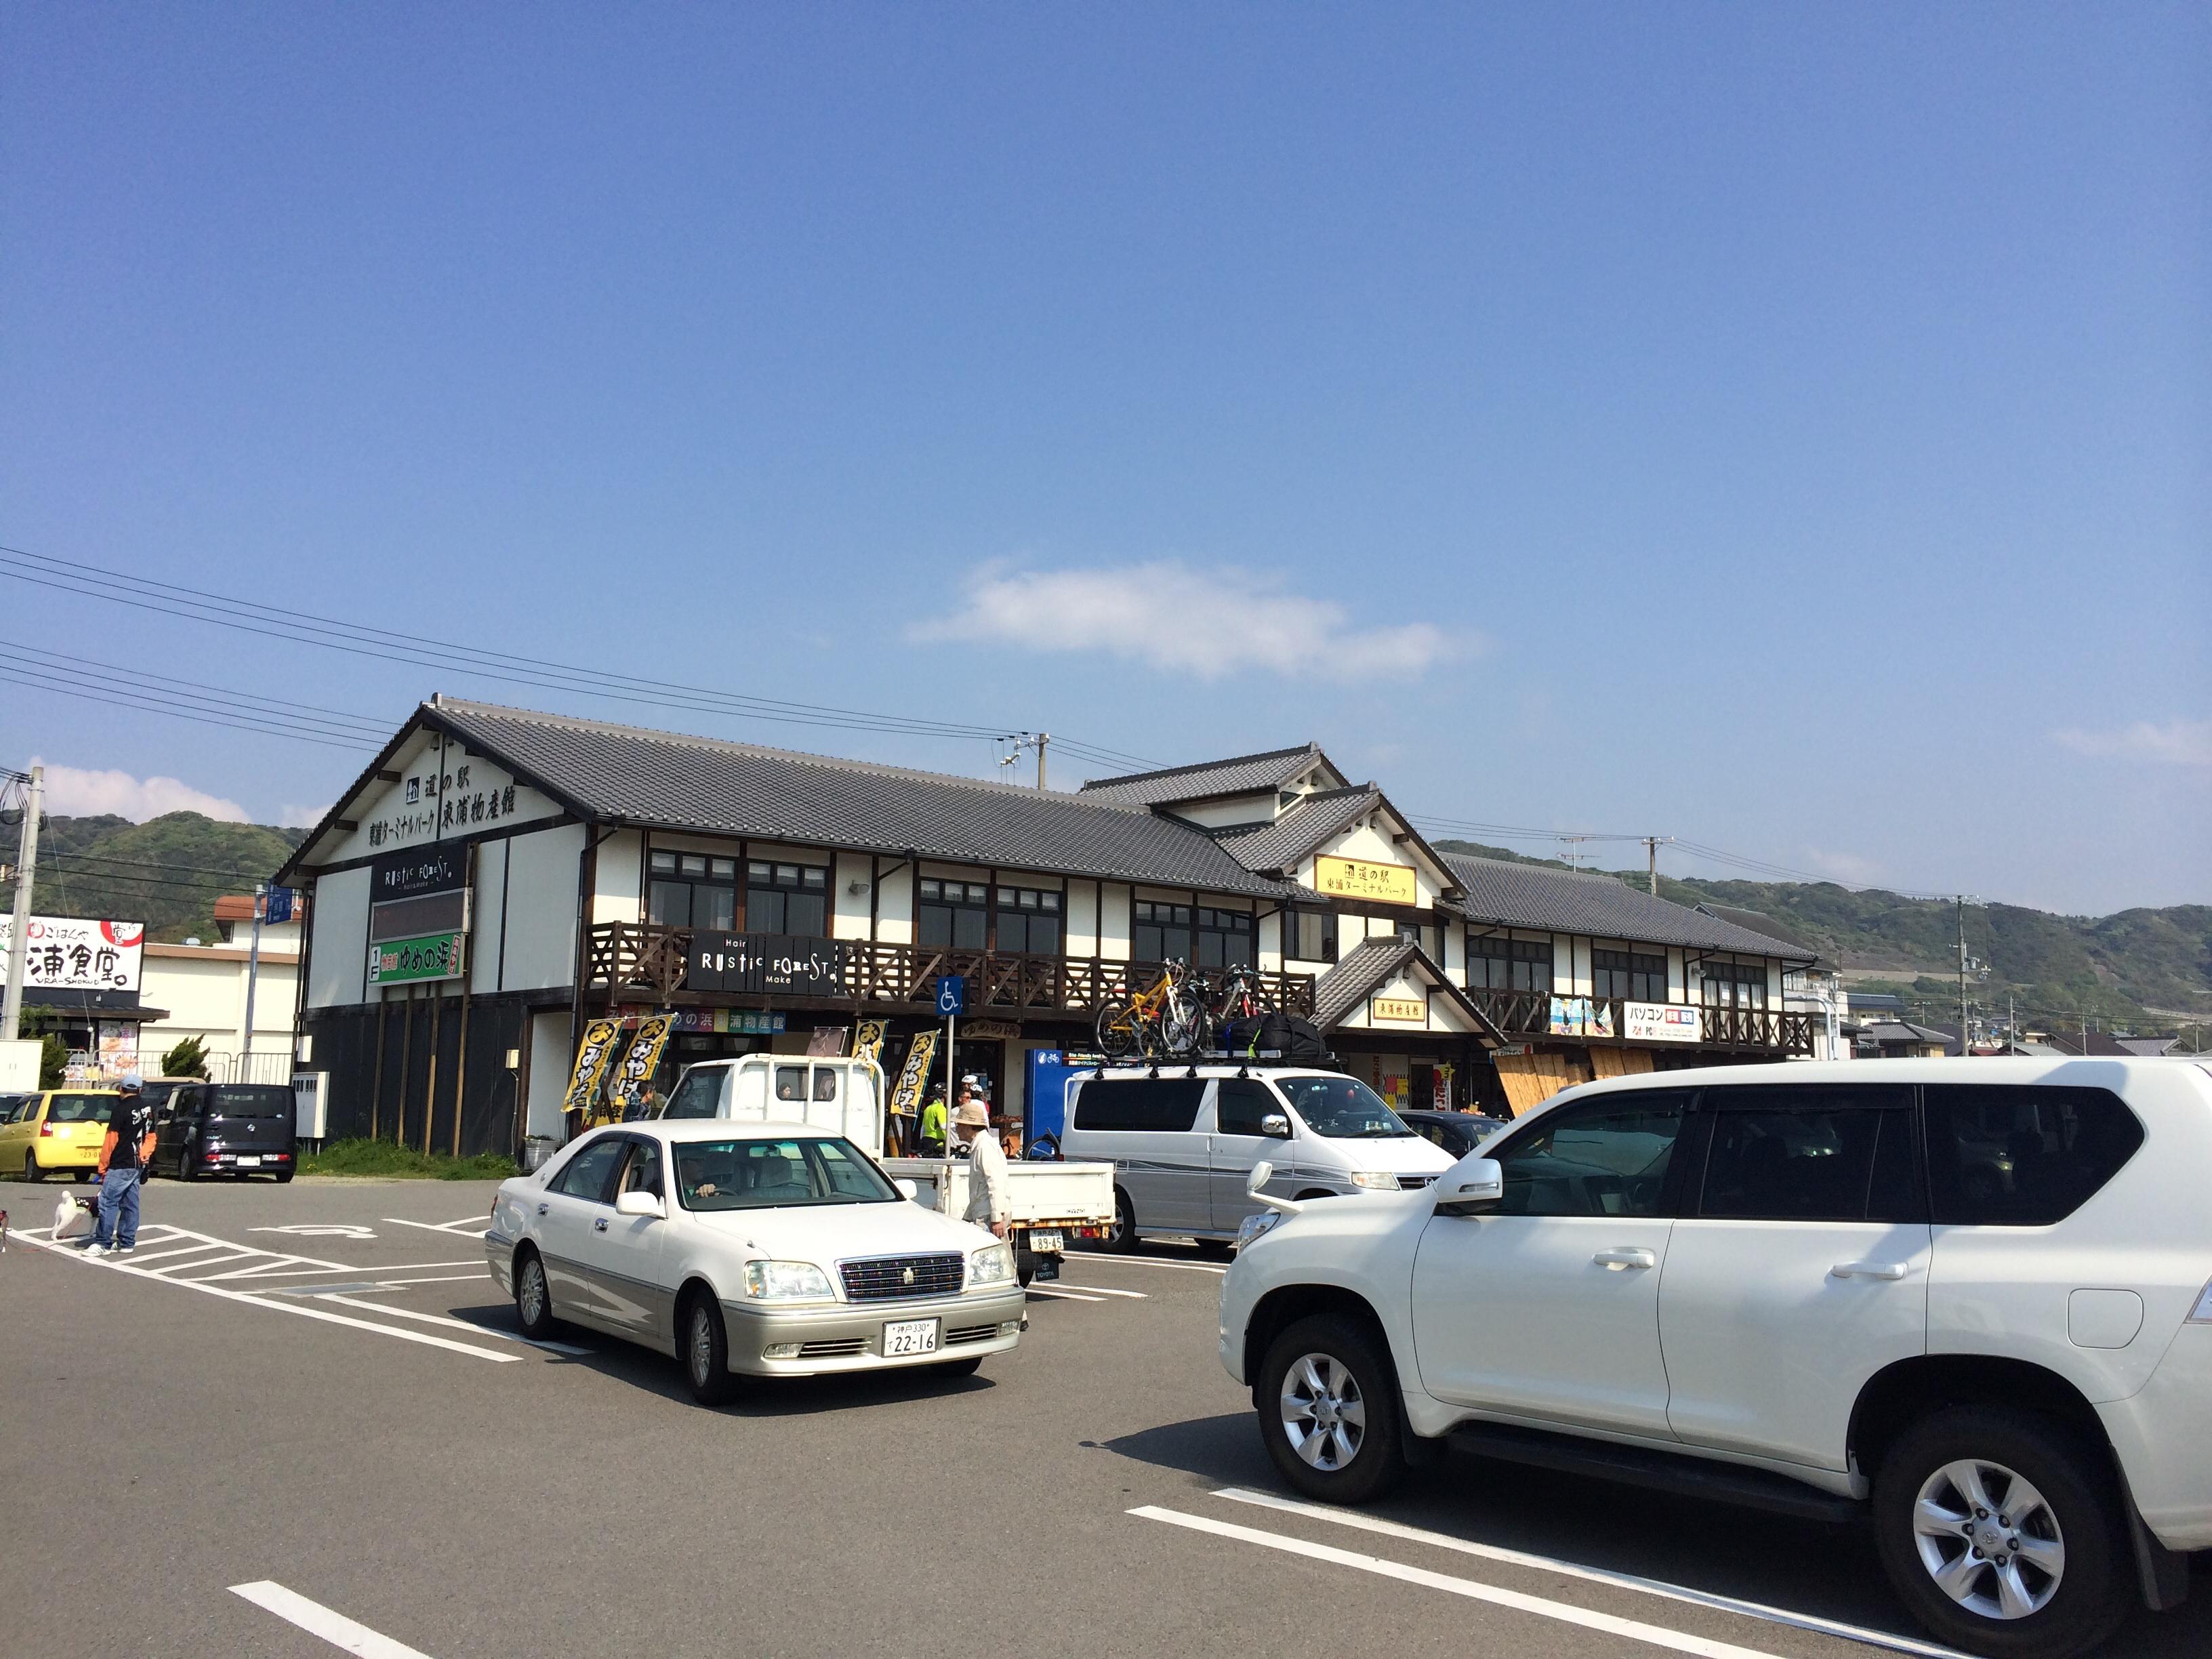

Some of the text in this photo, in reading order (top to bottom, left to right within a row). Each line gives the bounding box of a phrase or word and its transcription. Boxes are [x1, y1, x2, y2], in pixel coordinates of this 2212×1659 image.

[426, 765, 470, 797] 道の駅
[442, 785, 516, 830] 東浦物産館
[369, 809, 434, 846] 東浦ターミナルパーク
[1359, 866, 1389, 884] 道の駅
[1327, 878, 1406, 897] 東浦ターミナルパーク
[46, 926, 89, 941] ごはんや
[726, 939, 746, 948] Hair
[400, 941, 449, 975] ゆめの浜
[766, 975, 792, 984] Make
[1630, 1007, 1663, 1021] パソコン
[894, 1036, 932, 1109] おみやげ
[1038, 1237, 1062, 1250] 89-45
[895, 1333, 934, 1353] 22-16
